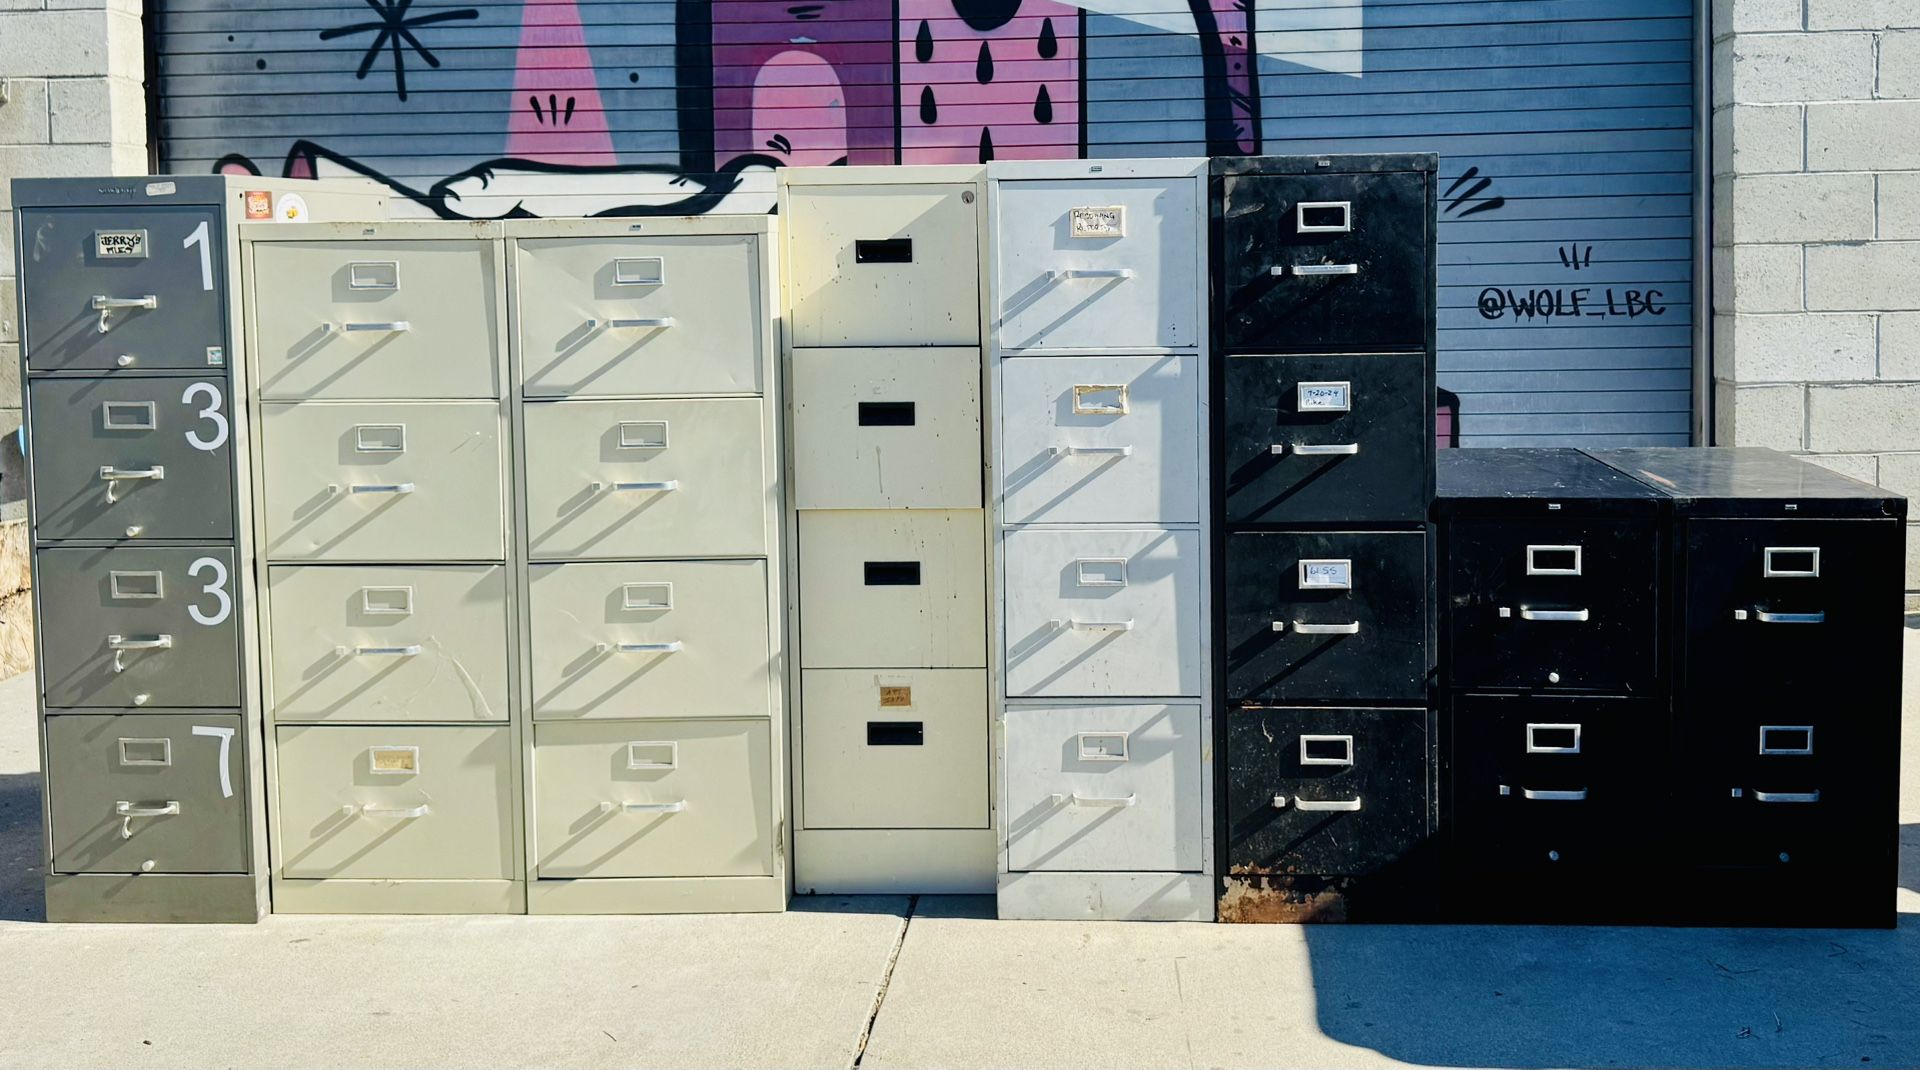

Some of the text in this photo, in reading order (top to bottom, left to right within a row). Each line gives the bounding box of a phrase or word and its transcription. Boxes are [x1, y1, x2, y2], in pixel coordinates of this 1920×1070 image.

[183, 221, 213, 290] 1
[1478, 287, 1666, 324] @WOLF_LBC
[182, 382, 229, 451] 3
[187, 557, 231, 626] 3
[192, 725, 235, 799] 7
